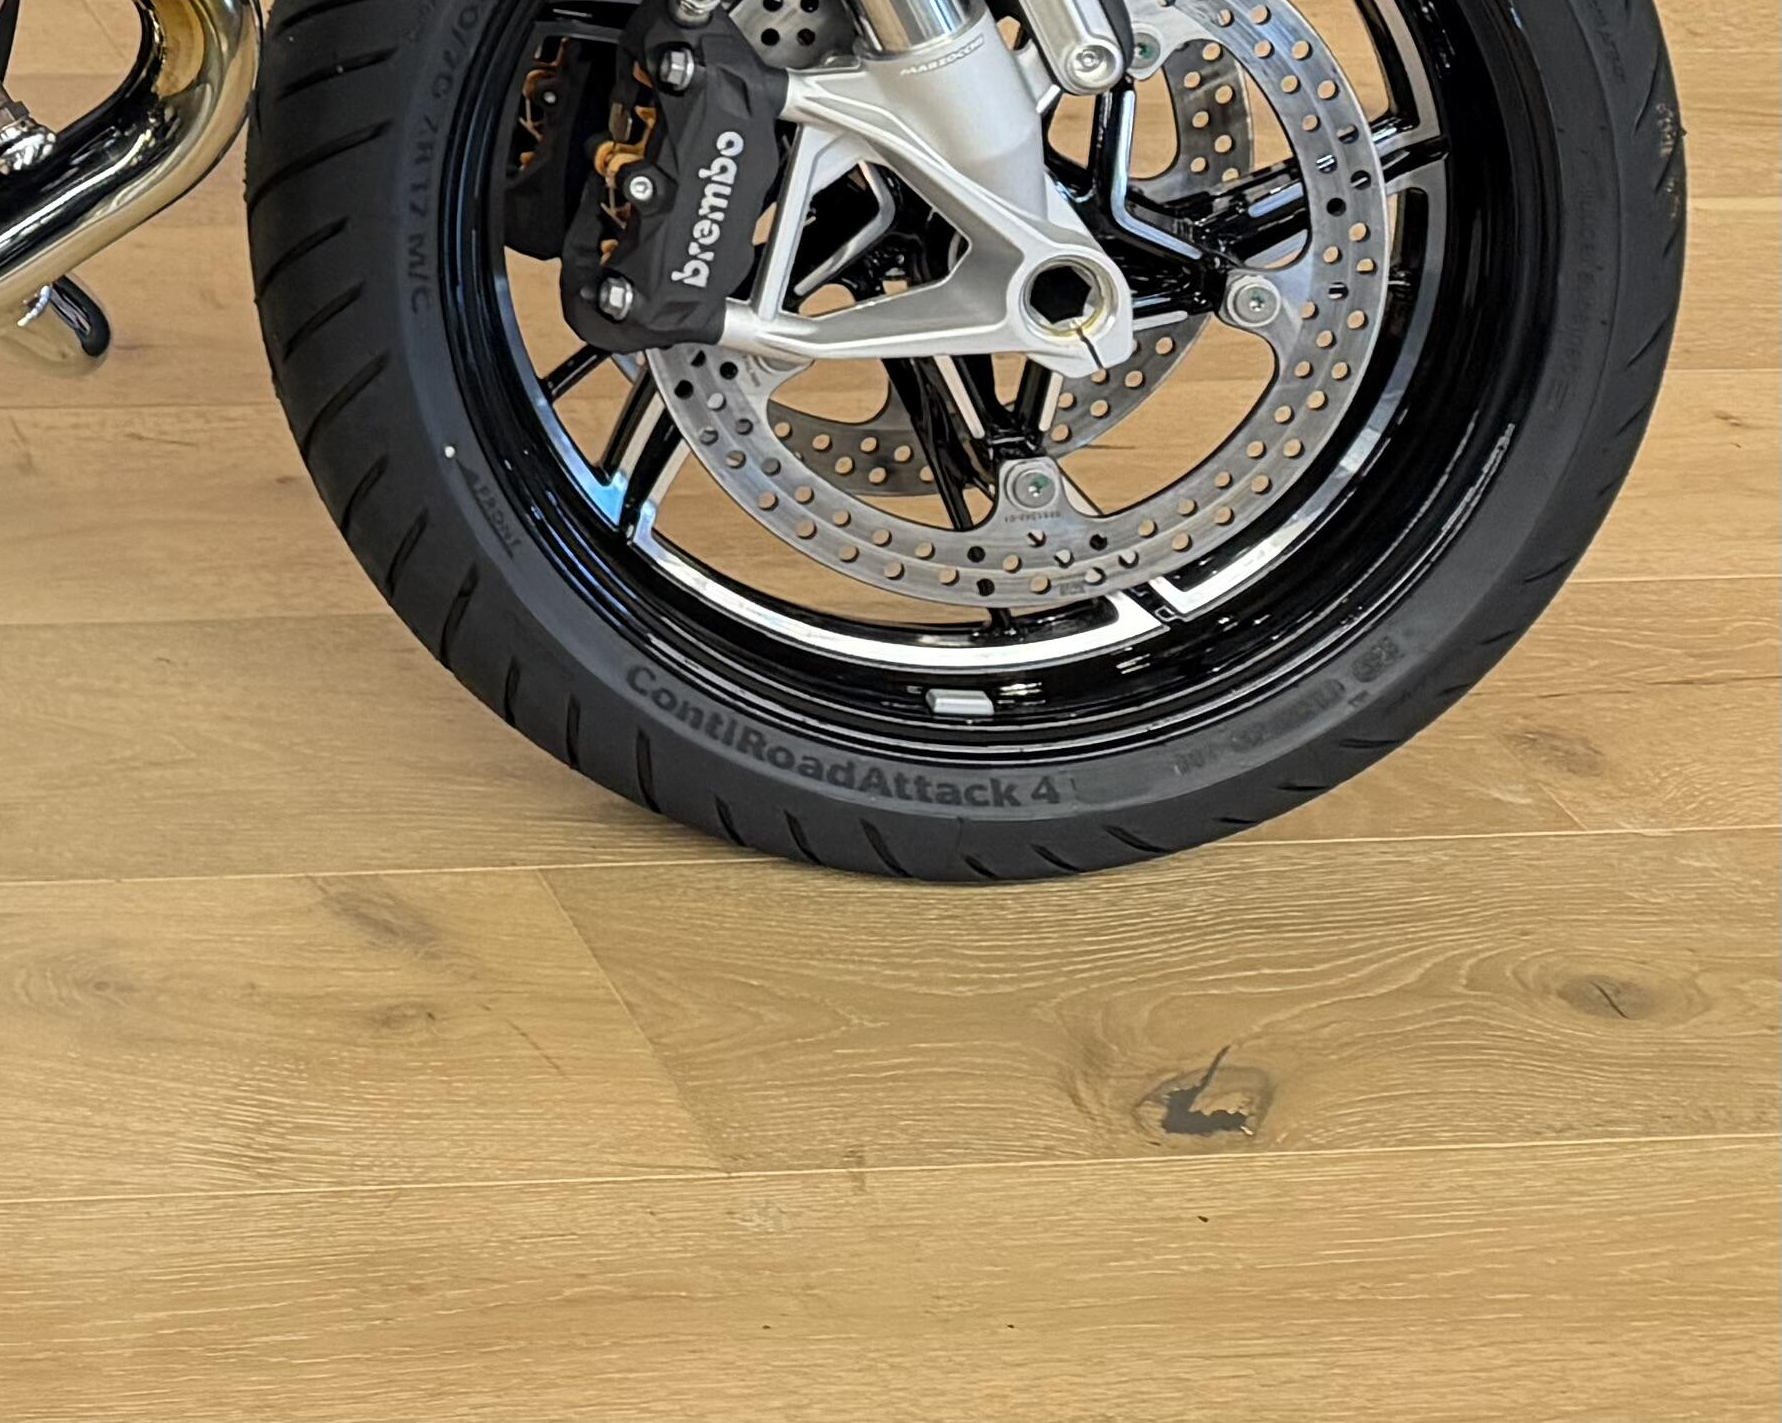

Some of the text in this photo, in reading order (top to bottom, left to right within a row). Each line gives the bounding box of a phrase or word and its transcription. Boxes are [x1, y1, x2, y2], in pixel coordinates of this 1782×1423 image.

[671, 131, 745, 288] brembo
[626, 661, 1061, 808] ContiRoadAttack 4
